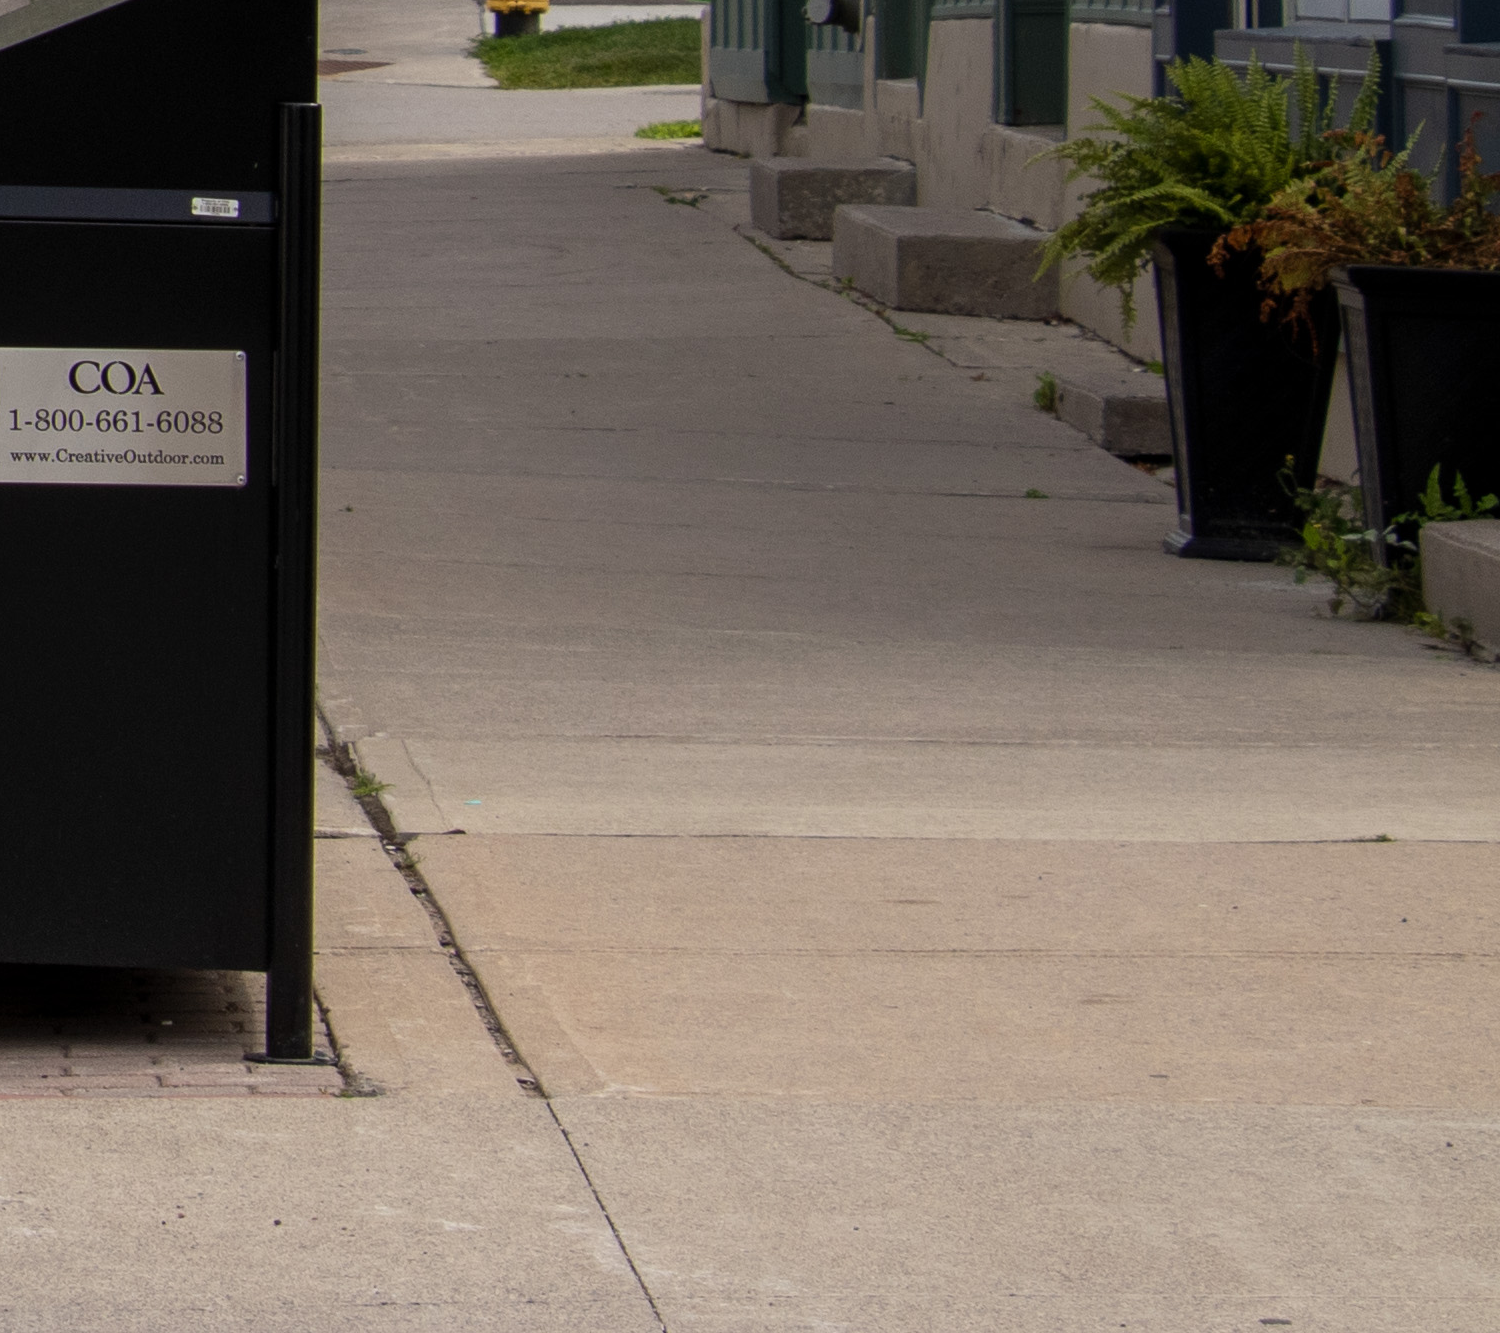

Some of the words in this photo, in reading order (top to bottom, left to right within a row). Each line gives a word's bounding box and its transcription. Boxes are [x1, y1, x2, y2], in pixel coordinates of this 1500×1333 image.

[68, 360, 164, 395] COA
[8, 409, 224, 434] 1-800-661-6088
[10, 448, 225, 466] www.CreativeOutdoor.com
